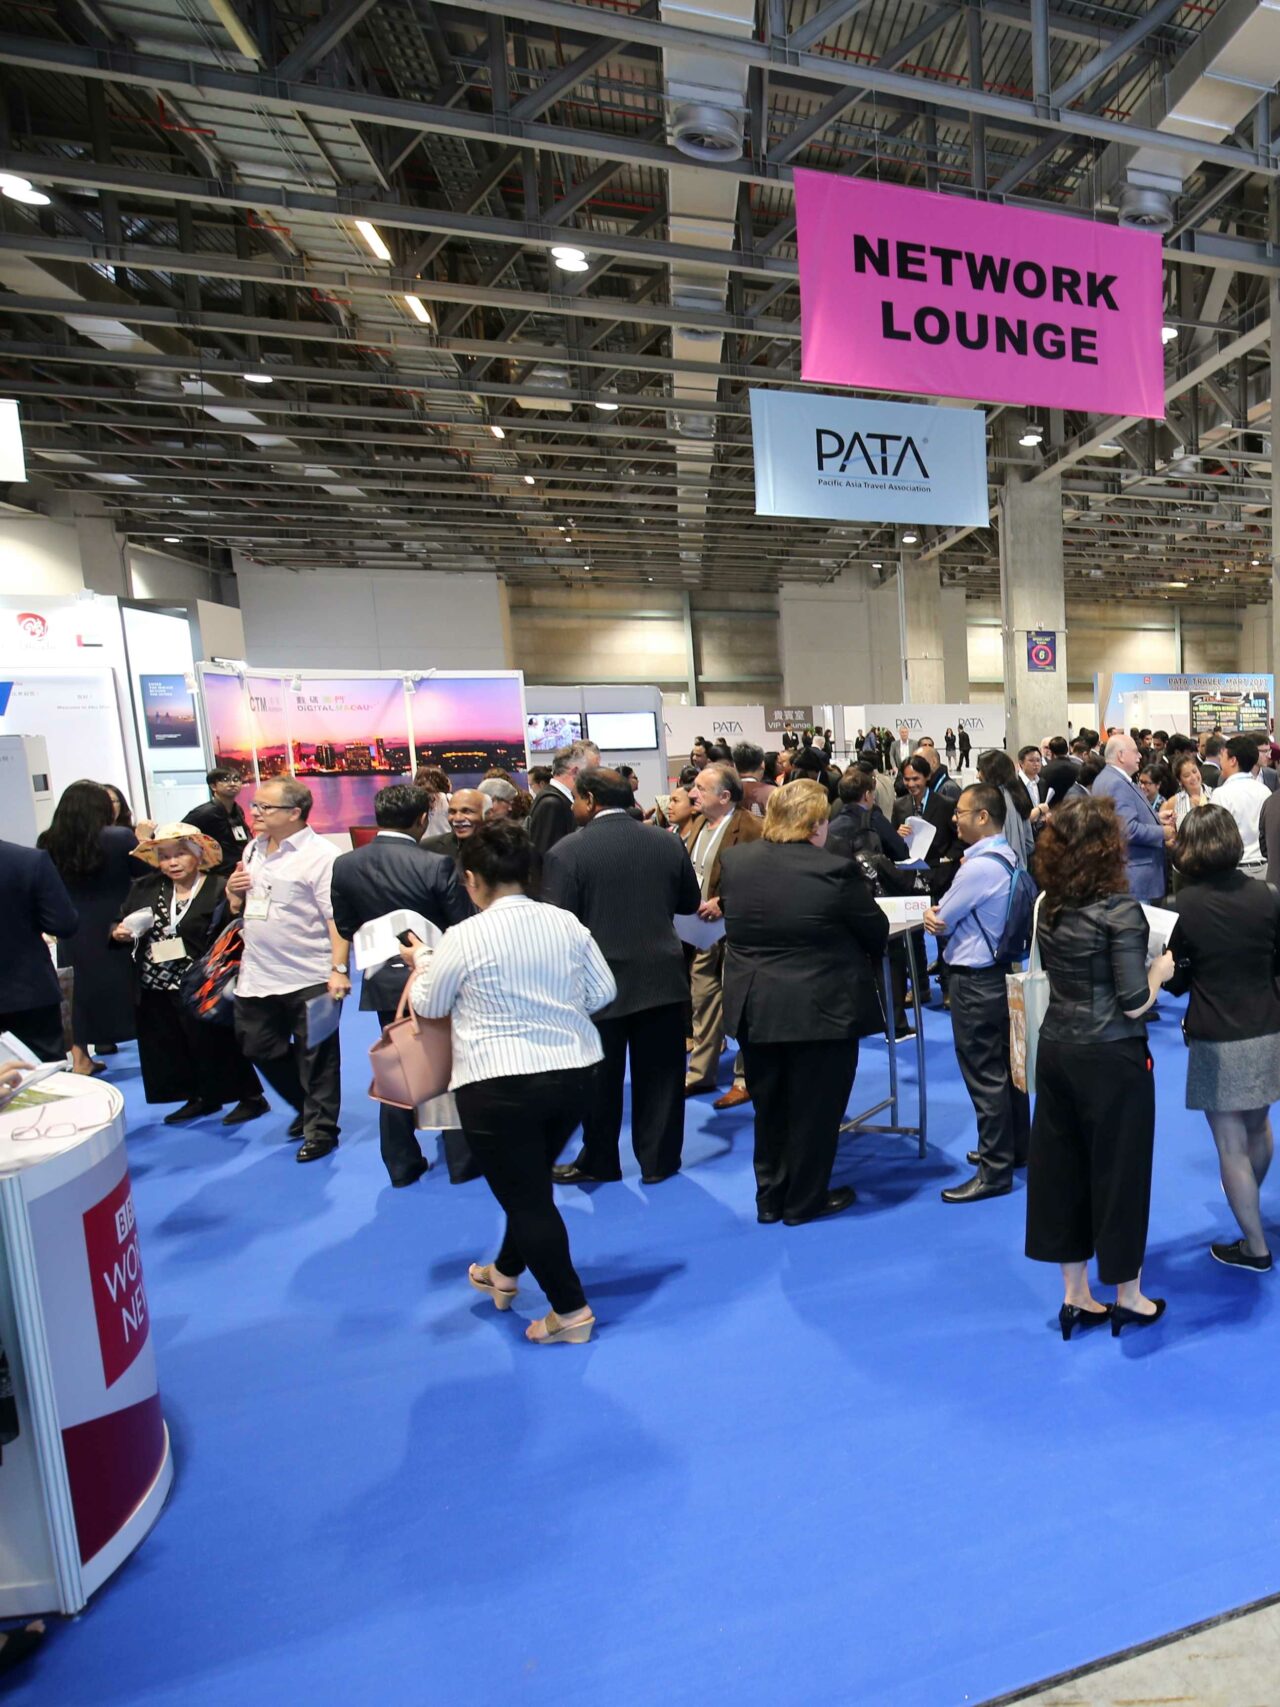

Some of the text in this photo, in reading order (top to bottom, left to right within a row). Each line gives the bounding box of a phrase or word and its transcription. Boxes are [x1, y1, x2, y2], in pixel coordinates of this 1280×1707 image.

[853, 234, 1120, 311] NETWORK
[881, 300, 1098, 365] LOUNGE
[816, 428, 930, 479] PATA
[818, 478, 931, 493] Pacific Asia Travel Association
[249, 696, 267, 712] CTM
[713, 721, 743, 733] PATA
[767, 721, 812, 731] VIP Lunge
[896, 718, 922, 729] PATA
[904, 901, 927, 911] cas
